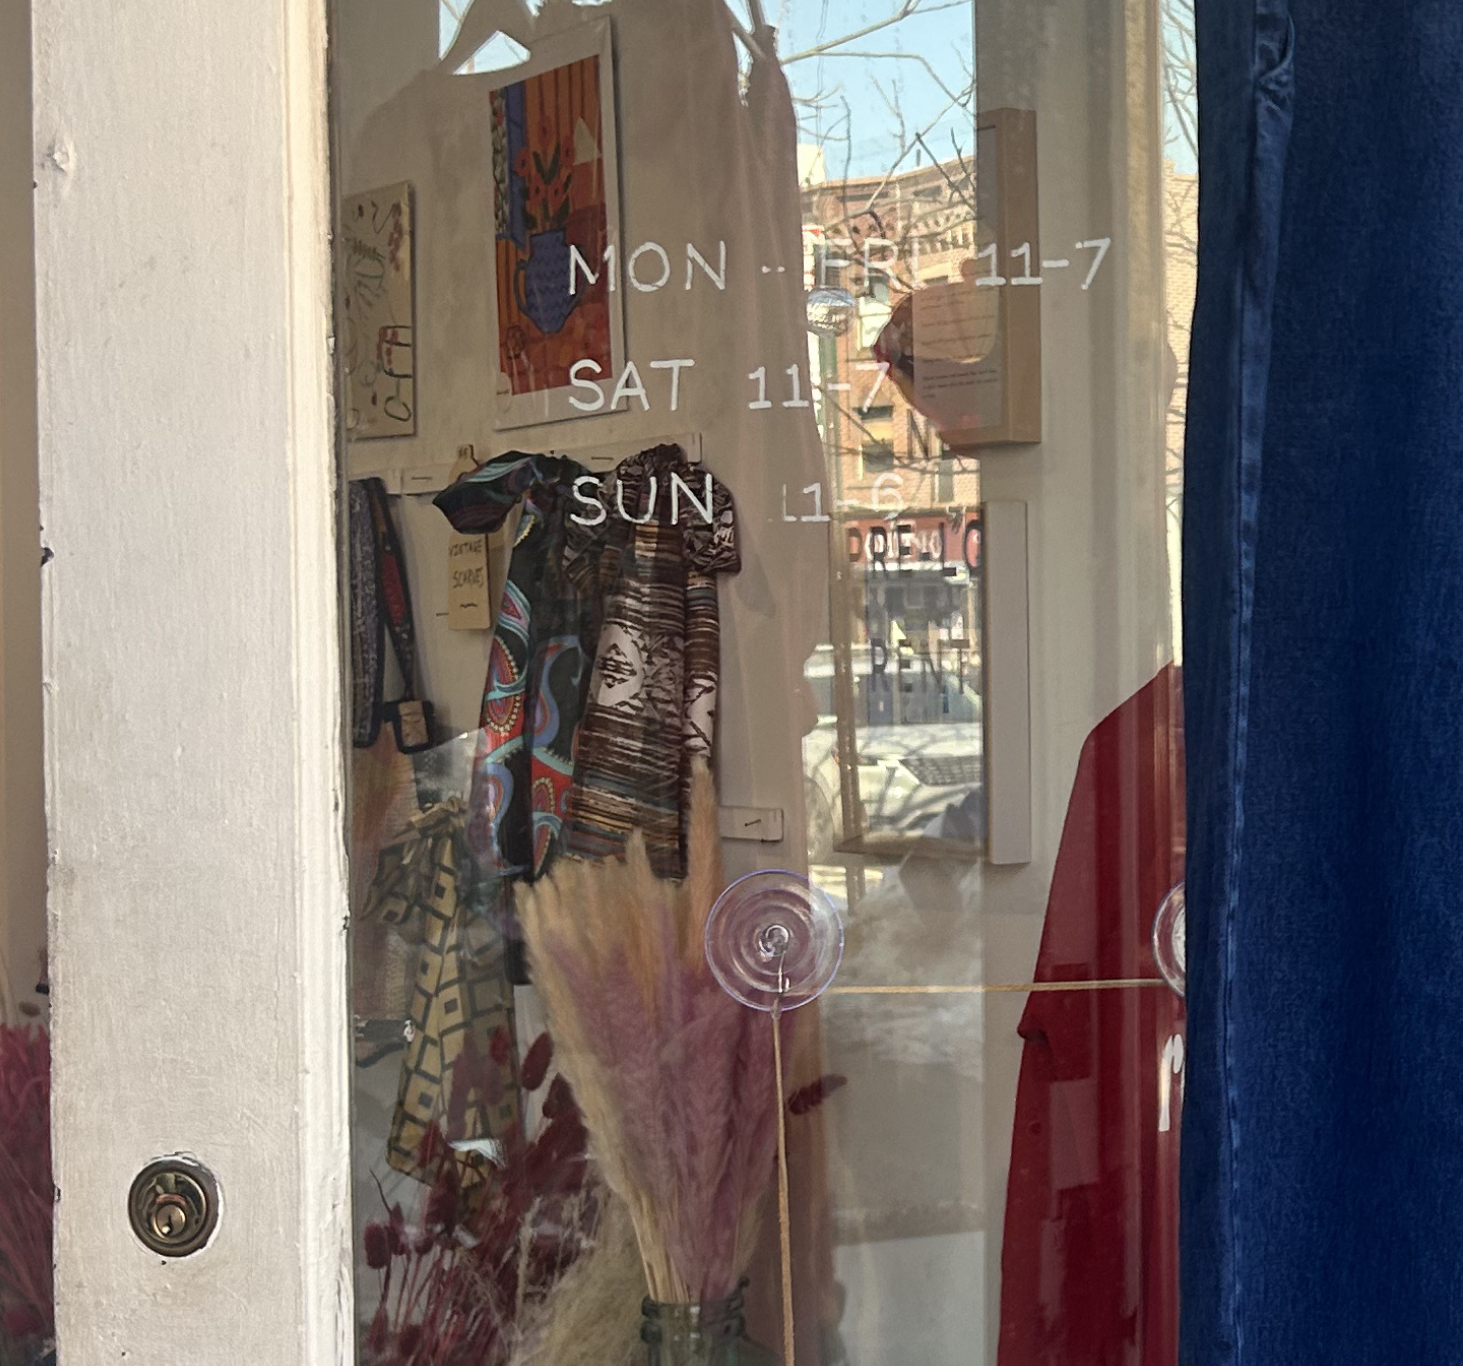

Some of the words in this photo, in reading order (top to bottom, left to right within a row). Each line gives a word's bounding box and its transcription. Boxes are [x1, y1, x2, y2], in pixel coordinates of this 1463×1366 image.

[568, 240, 727, 296] MON
[819, 237, 923, 290] FRI
[975, 237, 1112, 291] 11-7
[568, 358, 695, 412] SAT
[748, 361, 891, 413] 11-7
[569, 473, 715, 526] SUN
